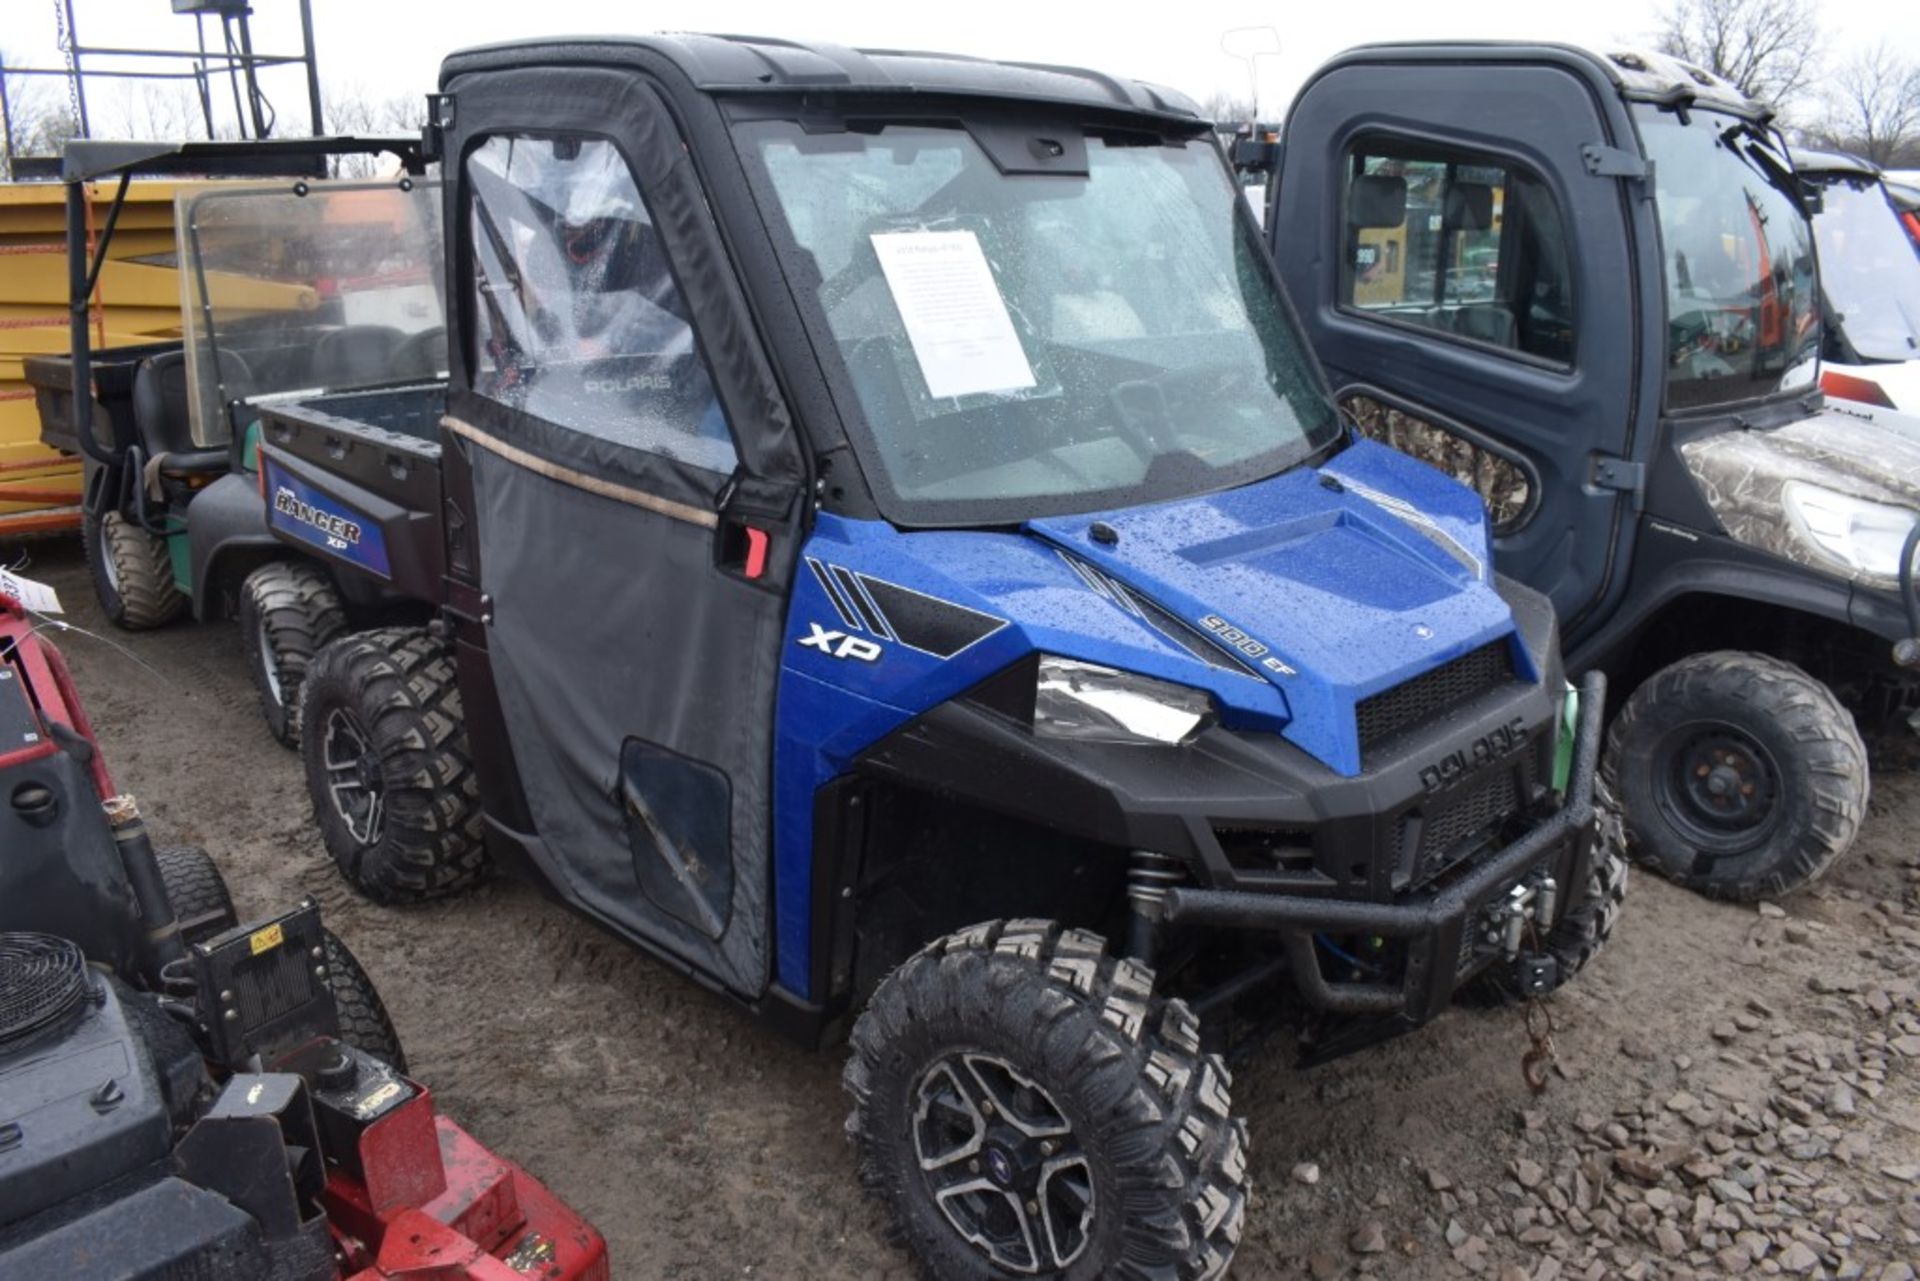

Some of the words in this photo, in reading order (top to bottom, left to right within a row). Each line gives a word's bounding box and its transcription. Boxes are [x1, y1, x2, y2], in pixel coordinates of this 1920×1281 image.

[584, 374, 672, 395] POLARIS
[274, 491, 361, 544] RANGER
[326, 536, 348, 549] XP
[796, 621, 882, 661] XP
[1198, 614, 1268, 659] 900
[1419, 716, 1529, 790] POLARIS
